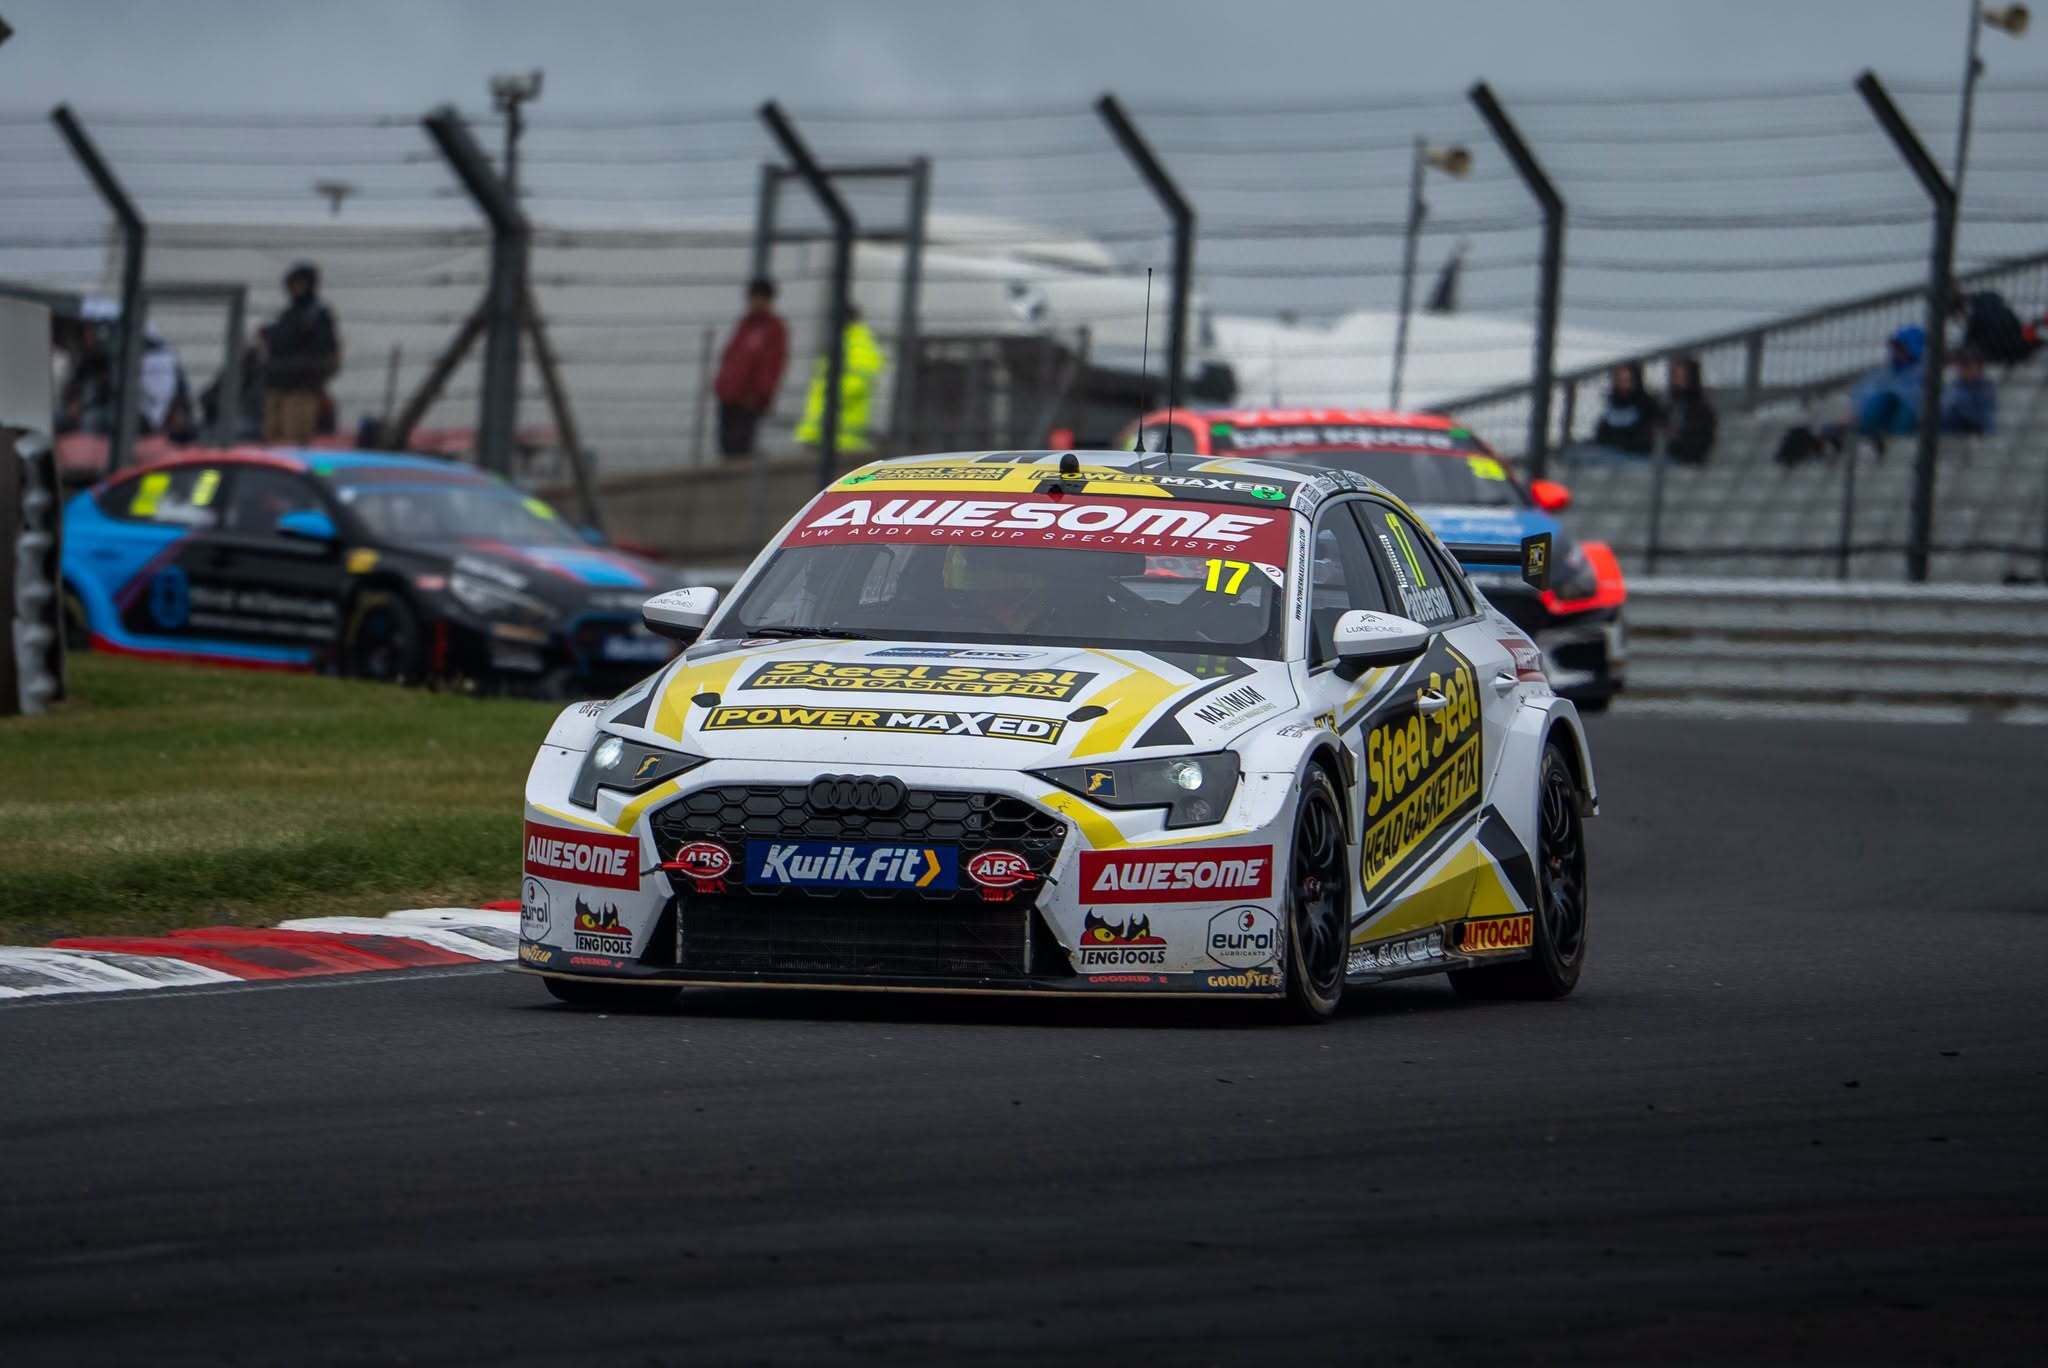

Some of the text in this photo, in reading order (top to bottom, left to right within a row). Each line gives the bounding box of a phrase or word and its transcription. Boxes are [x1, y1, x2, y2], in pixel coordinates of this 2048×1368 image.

[806, 499, 1275, 542] AWESOME
[801, 527, 1238, 552] VW AUDI GROUP SPECIALISTS
[1204, 558, 1250, 595] 17
[1398, 584, 1454, 622] Patterson
[760, 675, 1063, 697] HEAD GASKET FIX
[765, 661, 1077, 686] Steel Seal
[1194, 685, 1266, 725] MAXIMUM
[716, 708, 1051, 737] POWER MAXED
[1367, 667, 1478, 817] Steel Seal
[1363, 747, 1477, 881] HEAD GASKET FIX
[527, 835, 632, 877] AWESOME
[686, 851, 724, 868] ABS
[976, 859, 1022, 876] ABS
[1092, 858, 1265, 892] AWESOME
[1212, 927, 1274, 949] eurol
[1463, 917, 1532, 949] AUTOCAR
